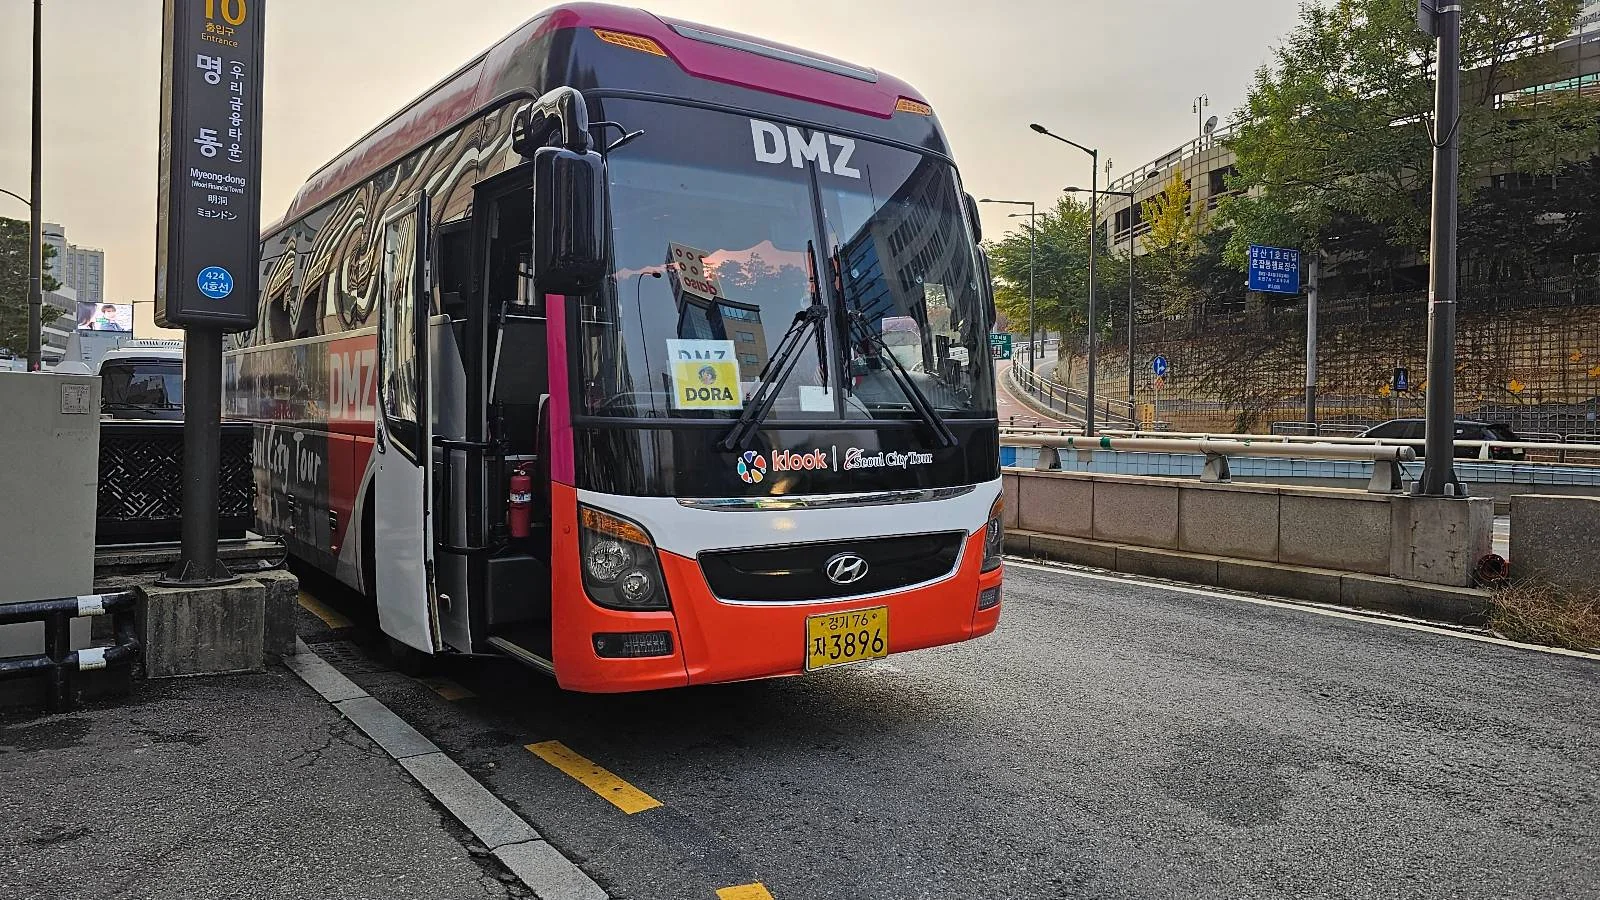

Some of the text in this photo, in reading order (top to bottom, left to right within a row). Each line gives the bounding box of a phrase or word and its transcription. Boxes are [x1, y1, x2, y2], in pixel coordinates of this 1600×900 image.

[205, 22, 235, 36] 출입구
[201, 33, 238, 48] Entrance
[228, 60, 246, 163] (우리금융타운)
[749, 118, 861, 179] DMZ
[190, 168, 246, 187] Myeong-dong
[207, 195, 228, 206] 明洞
[197, 207, 238, 220] ミョンドン
[205, 271, 224, 281] 424
[202, 282, 229, 293] 4호선
[329, 349, 376, 421] DMZ
[685, 387, 734, 401] DORA
[253, 425, 322, 494] oul City Tour
[771, 449, 933, 472] klook Seoul City Tour
[828, 613, 869, 630] 경기 76
